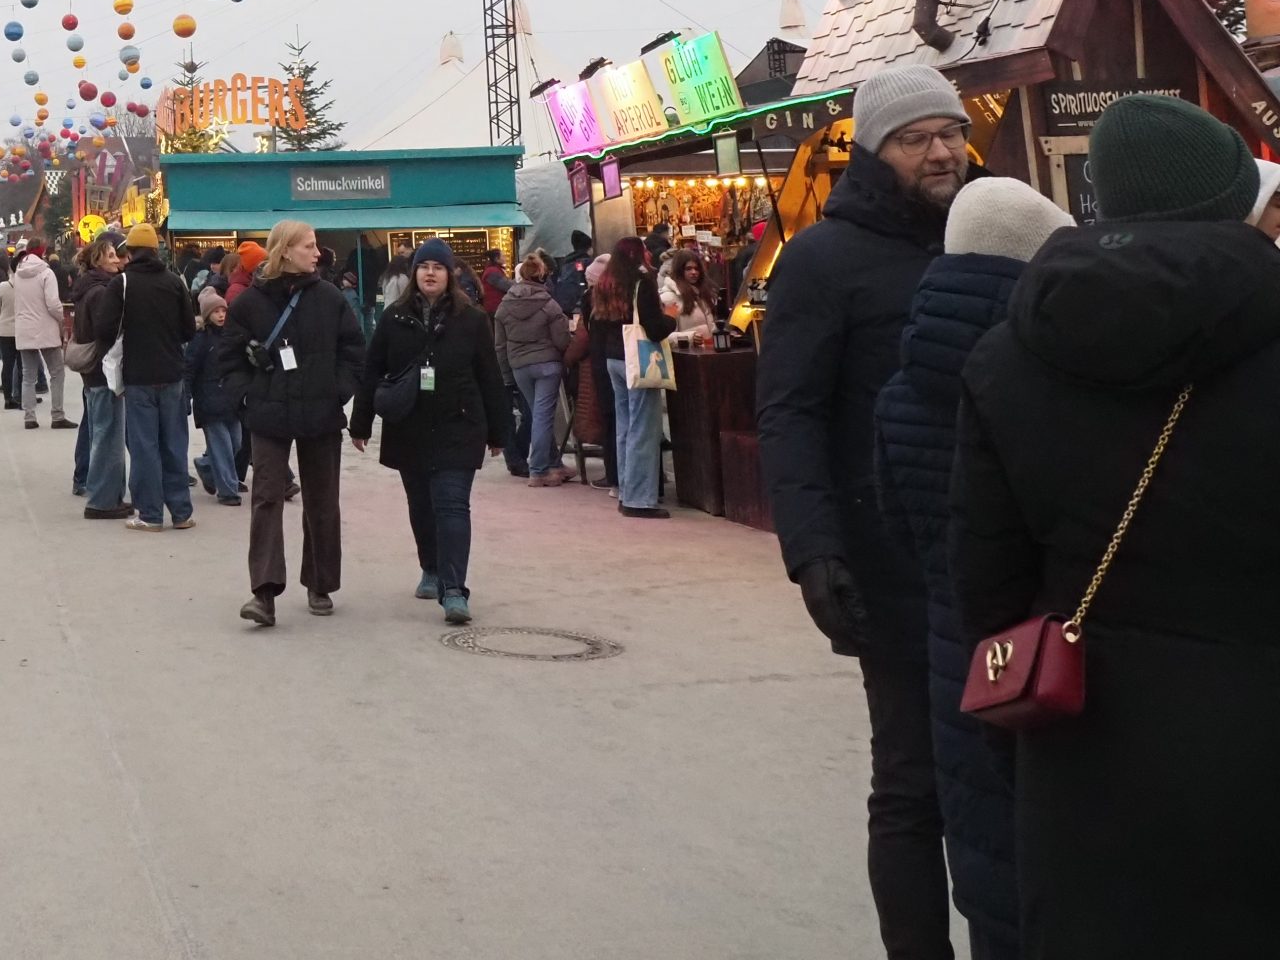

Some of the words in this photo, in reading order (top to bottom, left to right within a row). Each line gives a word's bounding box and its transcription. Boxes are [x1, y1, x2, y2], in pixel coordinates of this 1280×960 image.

[173, 73, 307, 135] BURGERS
[579, 102, 596, 142] GIN
[613, 100, 661, 136] APEROL
[765, 110, 815, 129] GIN
[826, 99, 842, 115] &
[296, 175, 385, 191] Schmuckwinkel
